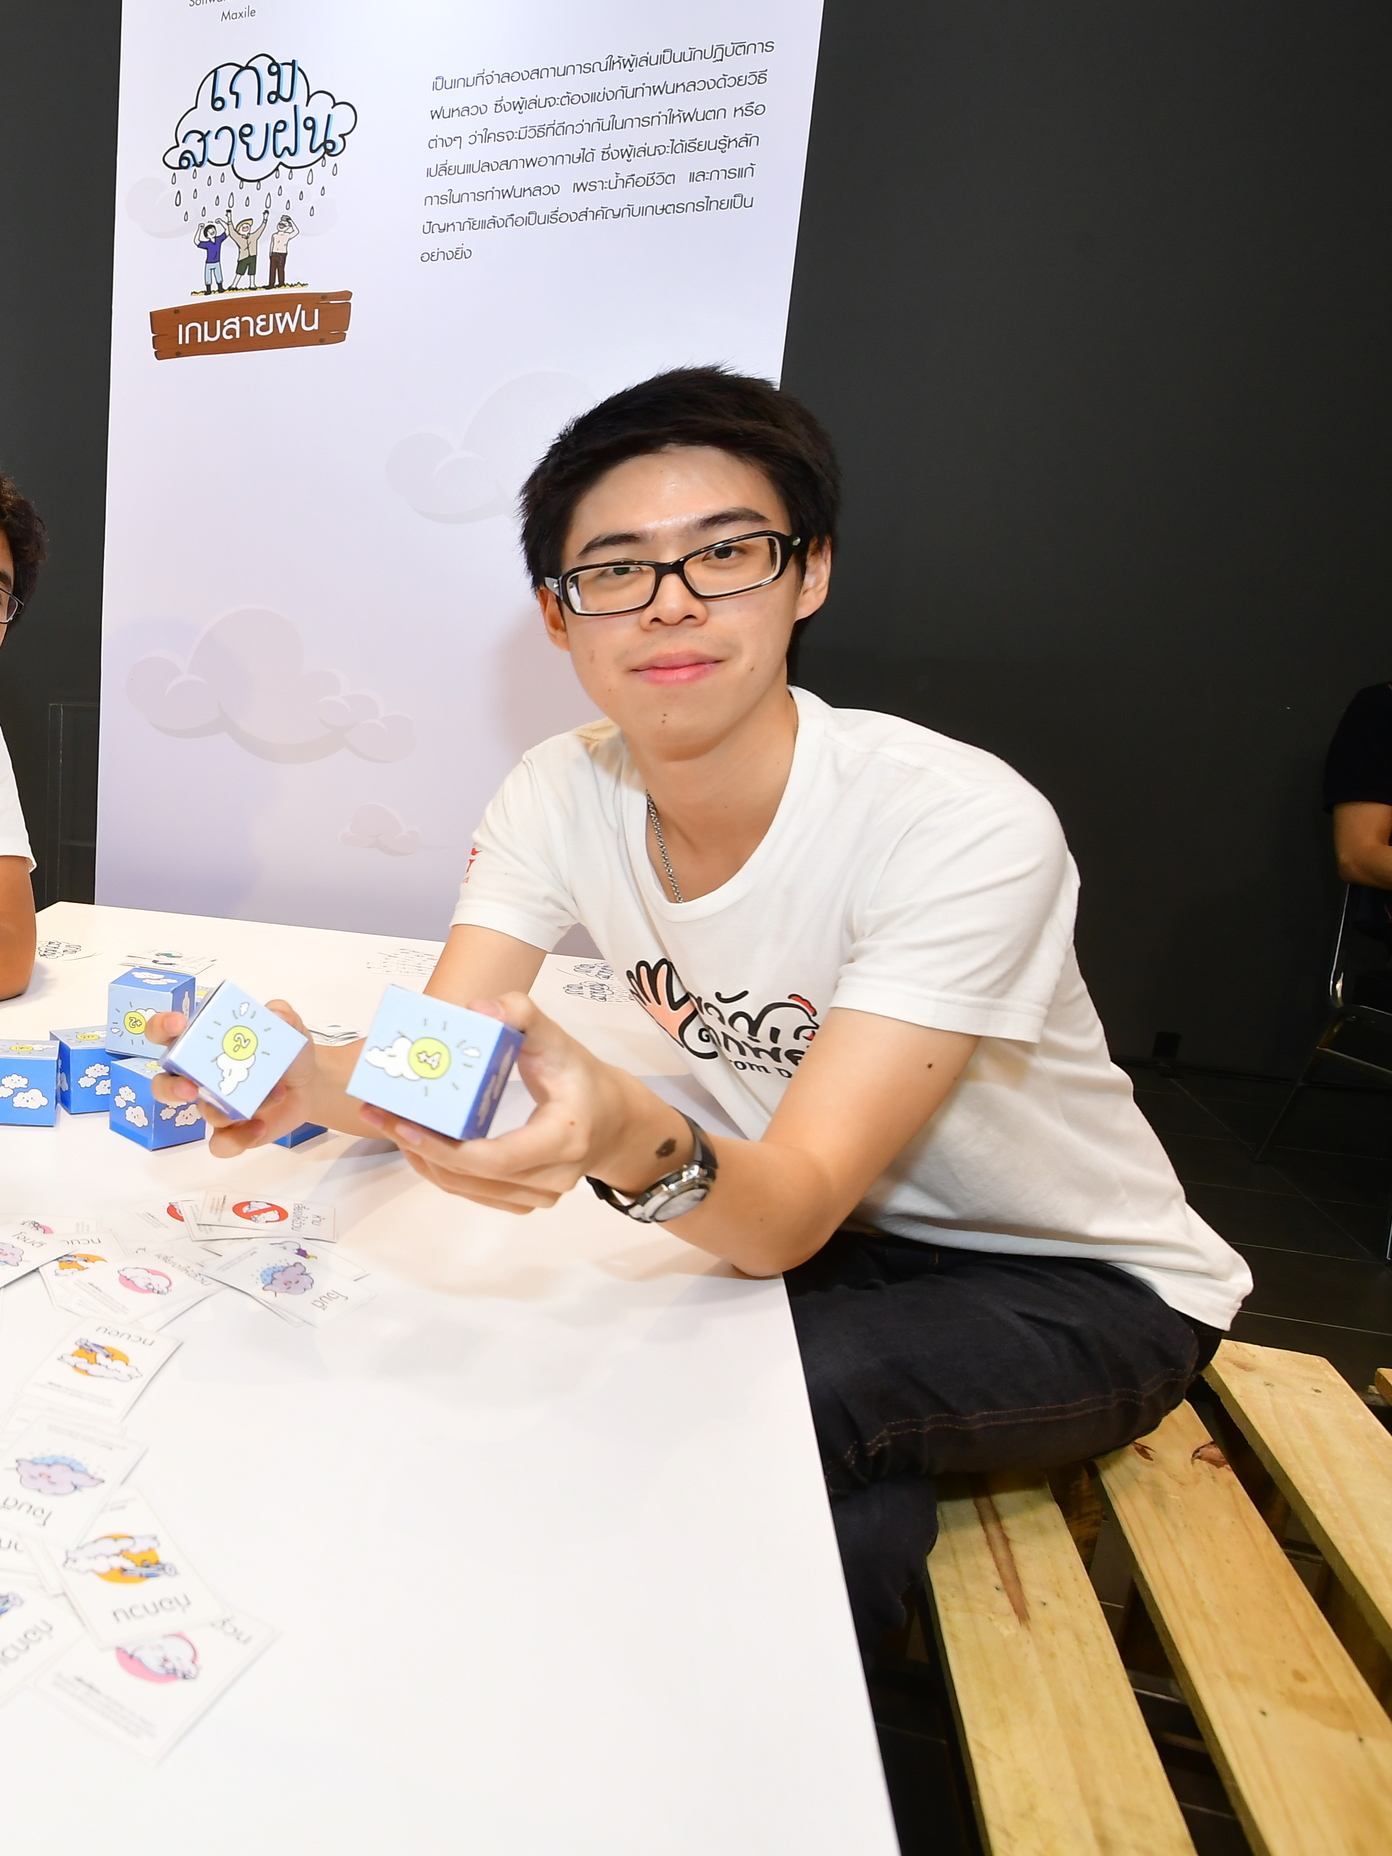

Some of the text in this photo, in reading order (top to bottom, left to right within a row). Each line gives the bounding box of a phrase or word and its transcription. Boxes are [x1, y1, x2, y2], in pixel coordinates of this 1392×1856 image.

[221, 5, 256, 22] Maxile
[211, 59, 299, 112] เกม
[431, 39, 775, 92] เป็นเกมที่จำลองสถานการณ์ให้ผู้เล่นเป็นนักปฏิบัติการ
[430, 68, 769, 120] ฝนหลวง ซึ่งผู้เล่นจะต้องแข่งกันทำฝนหลวงด้วยวิธี
[178, 104, 338, 170] สายฝน
[427, 101, 766, 149] ต่างๆ ว่าใครจะมีวิธีที่ดีกว่ากันในการทำให้ฝนตก หรือ
[601, 132, 760, 162] ซึ่งผู้เล่นจะได้เรียนรู้หลัก
[424, 162, 757, 206] การในการทำฝนหลวง เพราะน้ำคือชีวิต และการแก้
[422, 192, 755, 235] ปัญหาภัยแล้งถือเป็นเรื่องสำคัญกับเกษตรกรไทยเป็น
[420, 243, 473, 262] อย่างยิ่ง
[176, 303, 320, 346] เกมสายฝน
[232, 1032, 251, 1053] -2
[416, 1050, 443, 1071] +4
